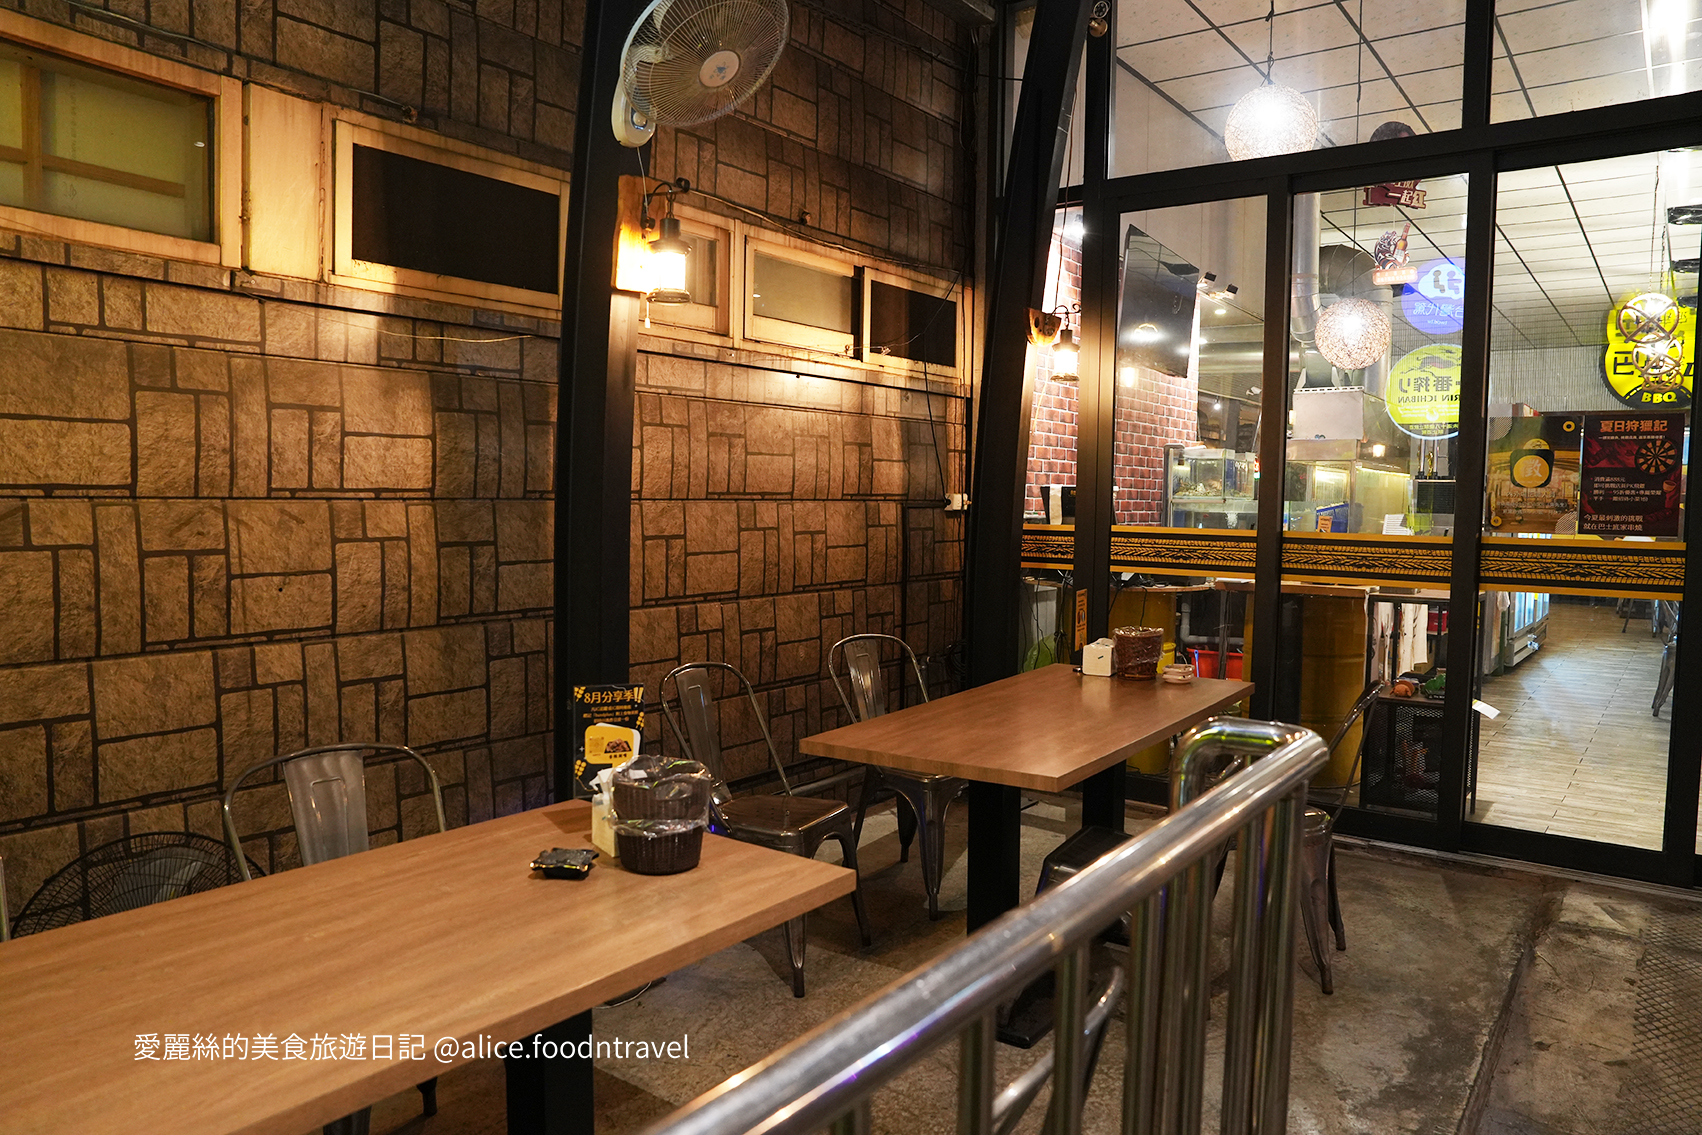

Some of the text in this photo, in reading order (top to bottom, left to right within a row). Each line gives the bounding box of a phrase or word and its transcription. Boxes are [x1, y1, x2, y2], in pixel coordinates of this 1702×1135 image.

[1641, 391, 1678, 404] BBQ
[1599, 420, 1668, 433] 夏日狩獵記
